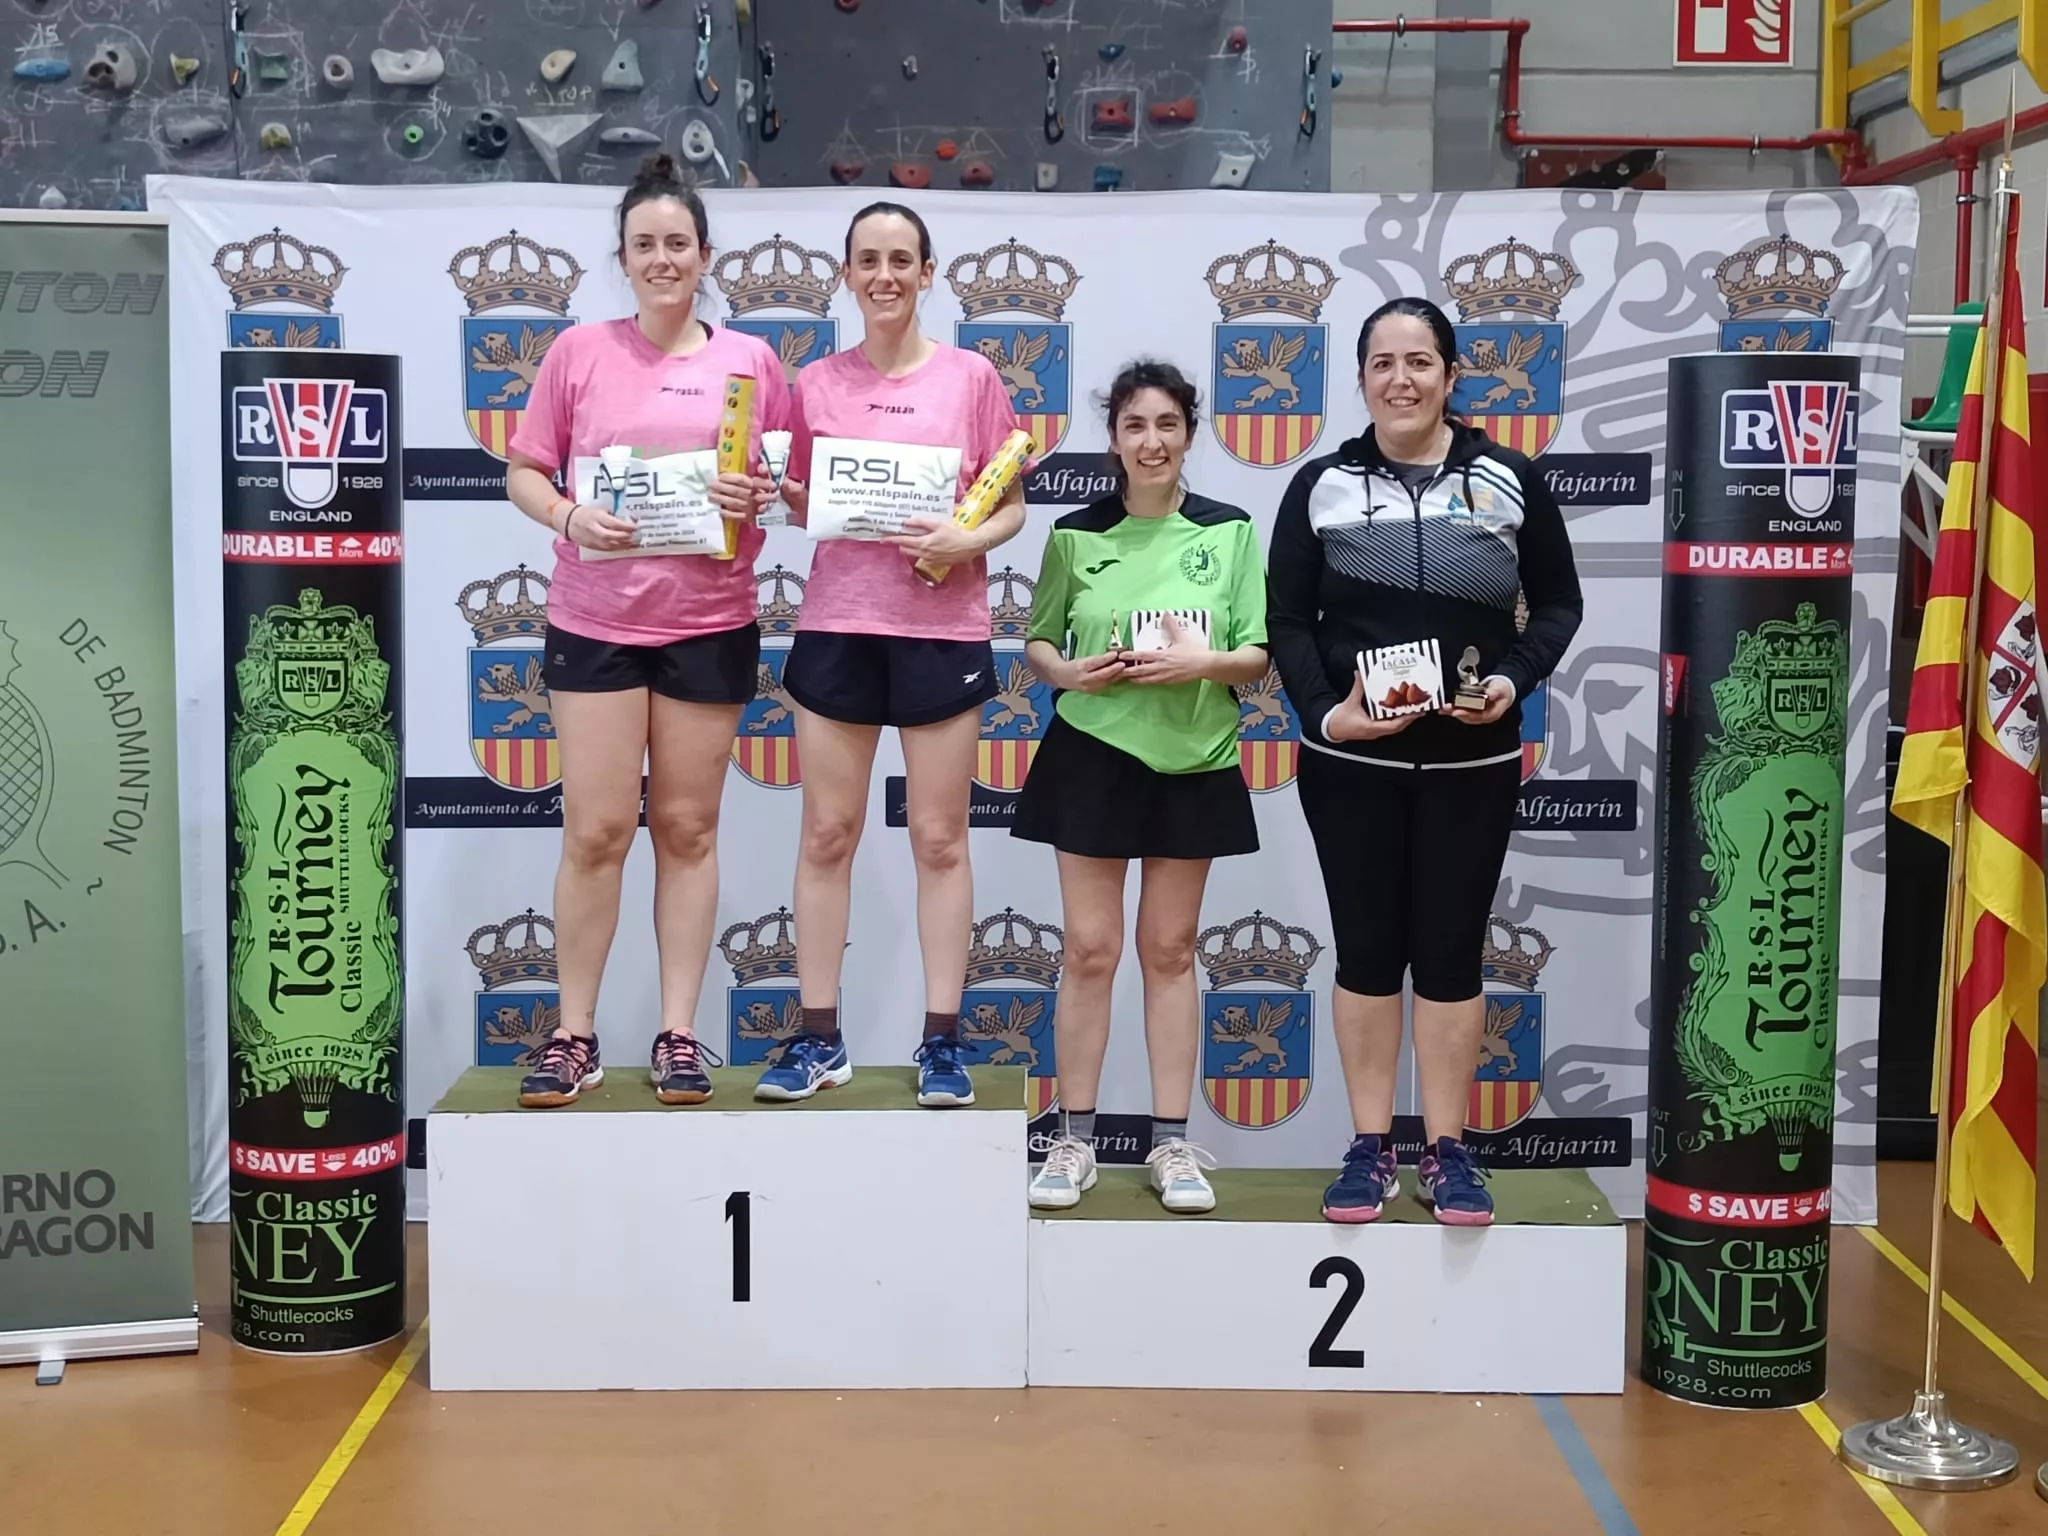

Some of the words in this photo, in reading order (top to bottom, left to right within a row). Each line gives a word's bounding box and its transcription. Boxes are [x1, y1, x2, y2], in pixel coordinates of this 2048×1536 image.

[238, 404, 382, 446] RSL
[237, 473, 279, 488] since
[342, 476, 383, 489] 1928
[409, 474, 507, 491] Ayuntamient
[829, 456, 916, 487] RSL
[832, 487, 941, 503] www.rslspain.es
[1725, 481, 1781, 497] since
[269, 510, 353, 523] ENGLAND
[1768, 519, 1843, 533] ENGLAND
[1688, 545, 1828, 570] DURABLE
[284, 674, 340, 690] RSL
[1777, 692, 1827, 709] RSL
[59, 618, 107, 665] DE
[94, 665, 151, 856] BADMINTON
[415, 802, 520, 819] Ayuntamiento
[522, 801, 540, 815] de
[1515, 796, 1624, 825] Alfajarín
[340, 792, 351, 914] SHUTTLECOCKS
[268, 764, 351, 1015] Tourney
[1817, 816, 1829, 946] SHUTTLECOCKS
[1746, 787, 1830, 1053] Tourney
[340, 921, 363, 1014] Classic
[1813, 951, 1831, 1050] Classic
[323, 1044, 364, 1061] 1928
[247, 1151, 317, 1174] SAVE
[352, 1140, 397, 1169] 40%
[1480, 1143, 1496, 1155] de
[1502, 1135, 1618, 1164] Alfajarín
[256, 1188, 378, 1222] Classic
[1688, 1192, 1703, 1214] $
[1708, 1195, 1789, 1220] SAVE
[724, 1191, 751, 1303] 1
[1720, 1234, 1829, 1271] Classic
[250, 1303, 354, 1325] Shuttlecocks
[1308, 1256, 1366, 1369] 2
[1656, 1365, 1772, 1400] 1928.com
[1707, 1358, 1812, 1379] Shuttlecocks
